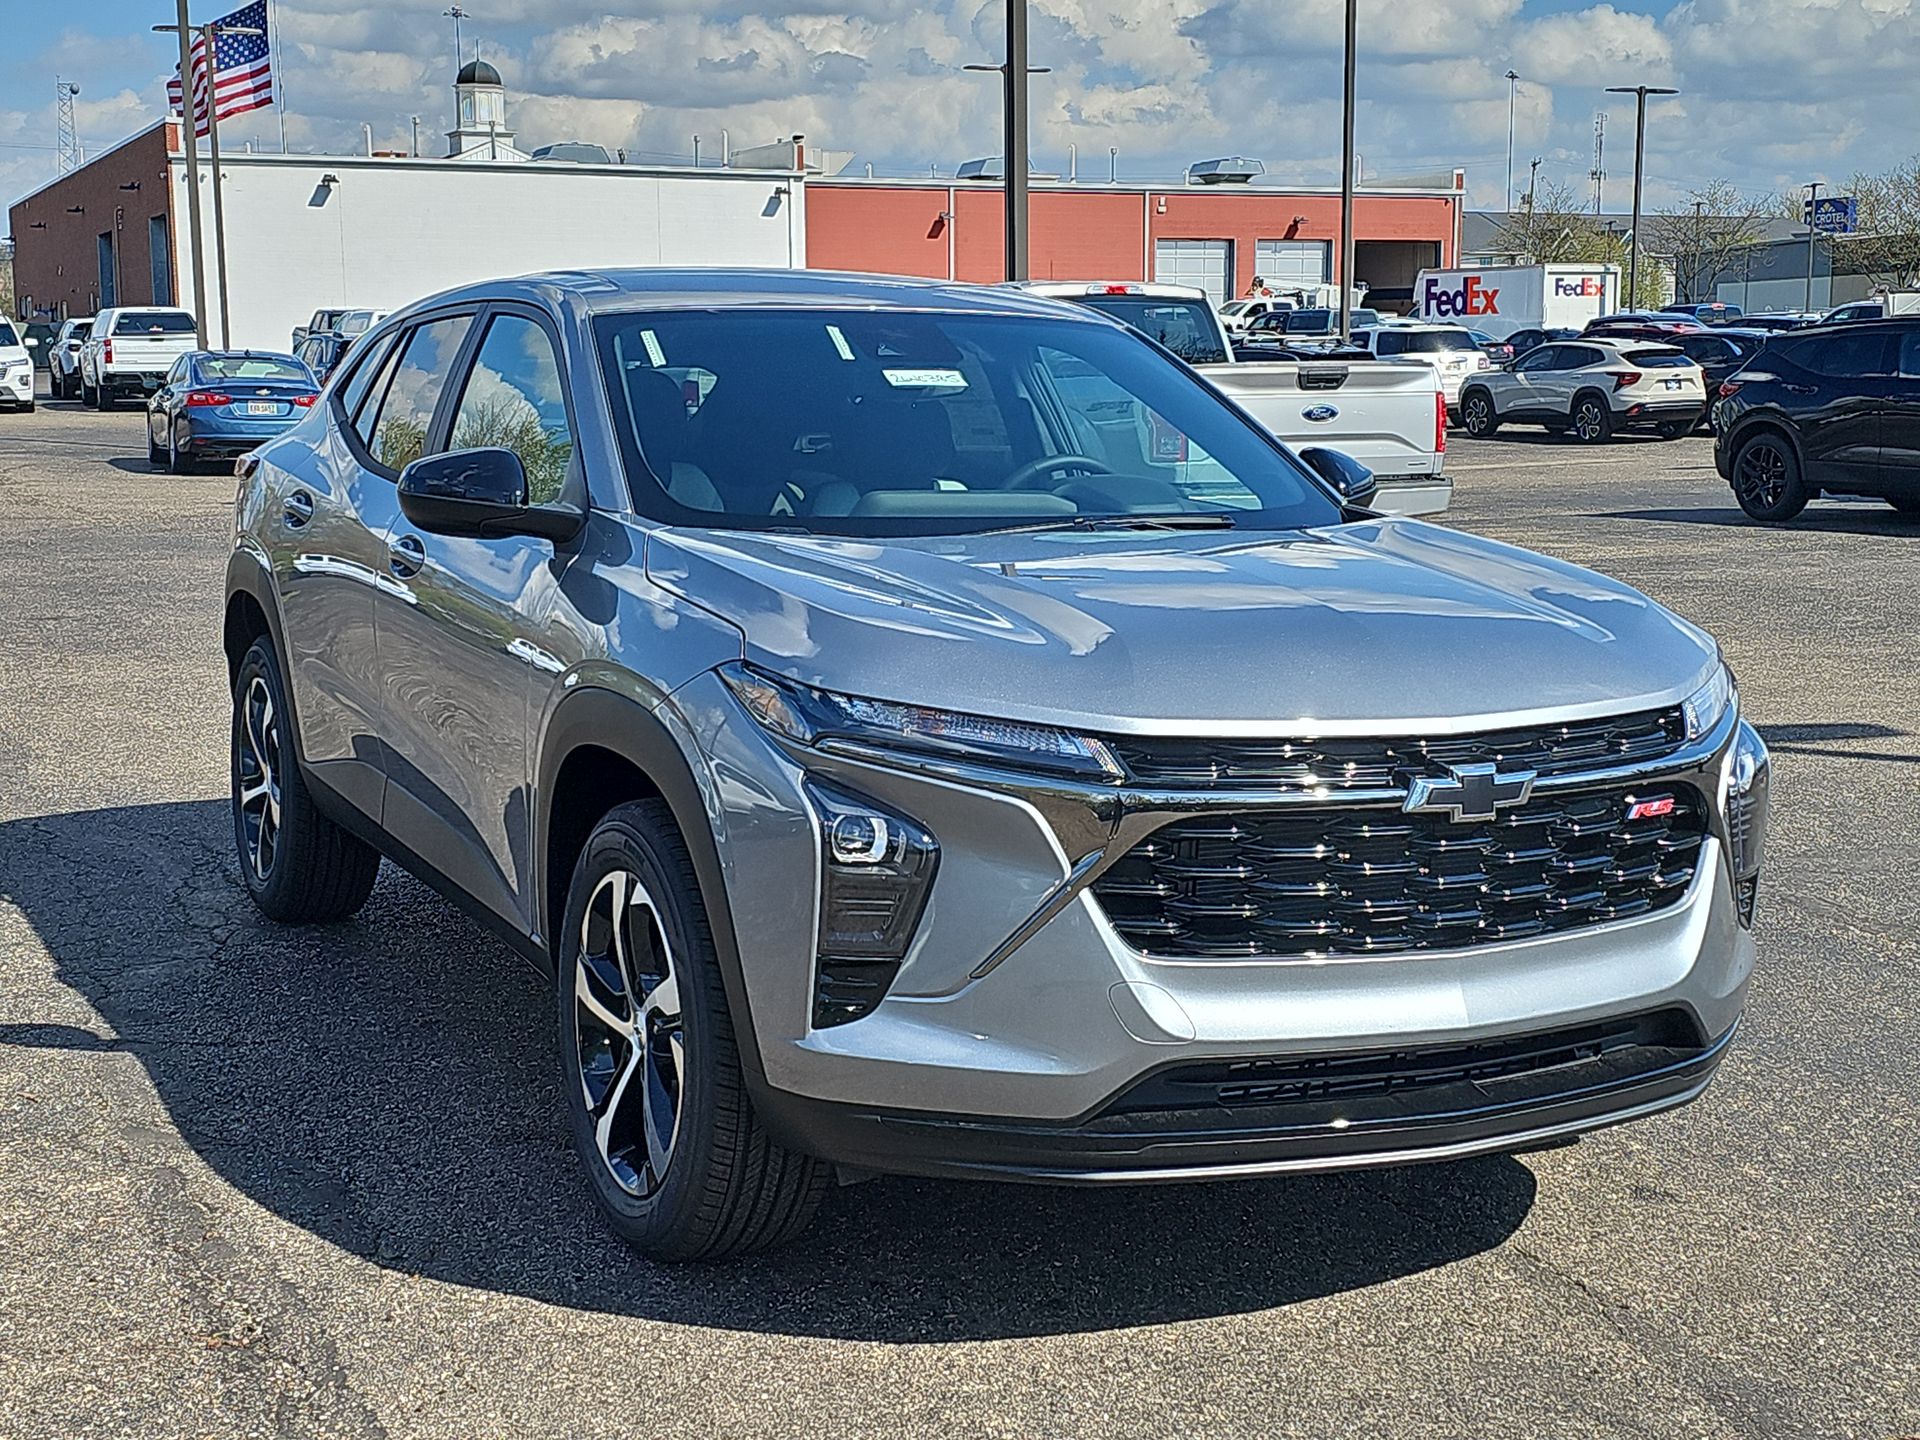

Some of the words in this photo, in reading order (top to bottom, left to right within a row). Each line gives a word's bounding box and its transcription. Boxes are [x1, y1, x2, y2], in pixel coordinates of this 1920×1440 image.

[1806, 212, 1846, 224] CROTEL
[1425, 276, 1500, 316] FedEx
[1555, 277, 1605, 296] FedEx
[1628, 798, 1675, 819] RS
